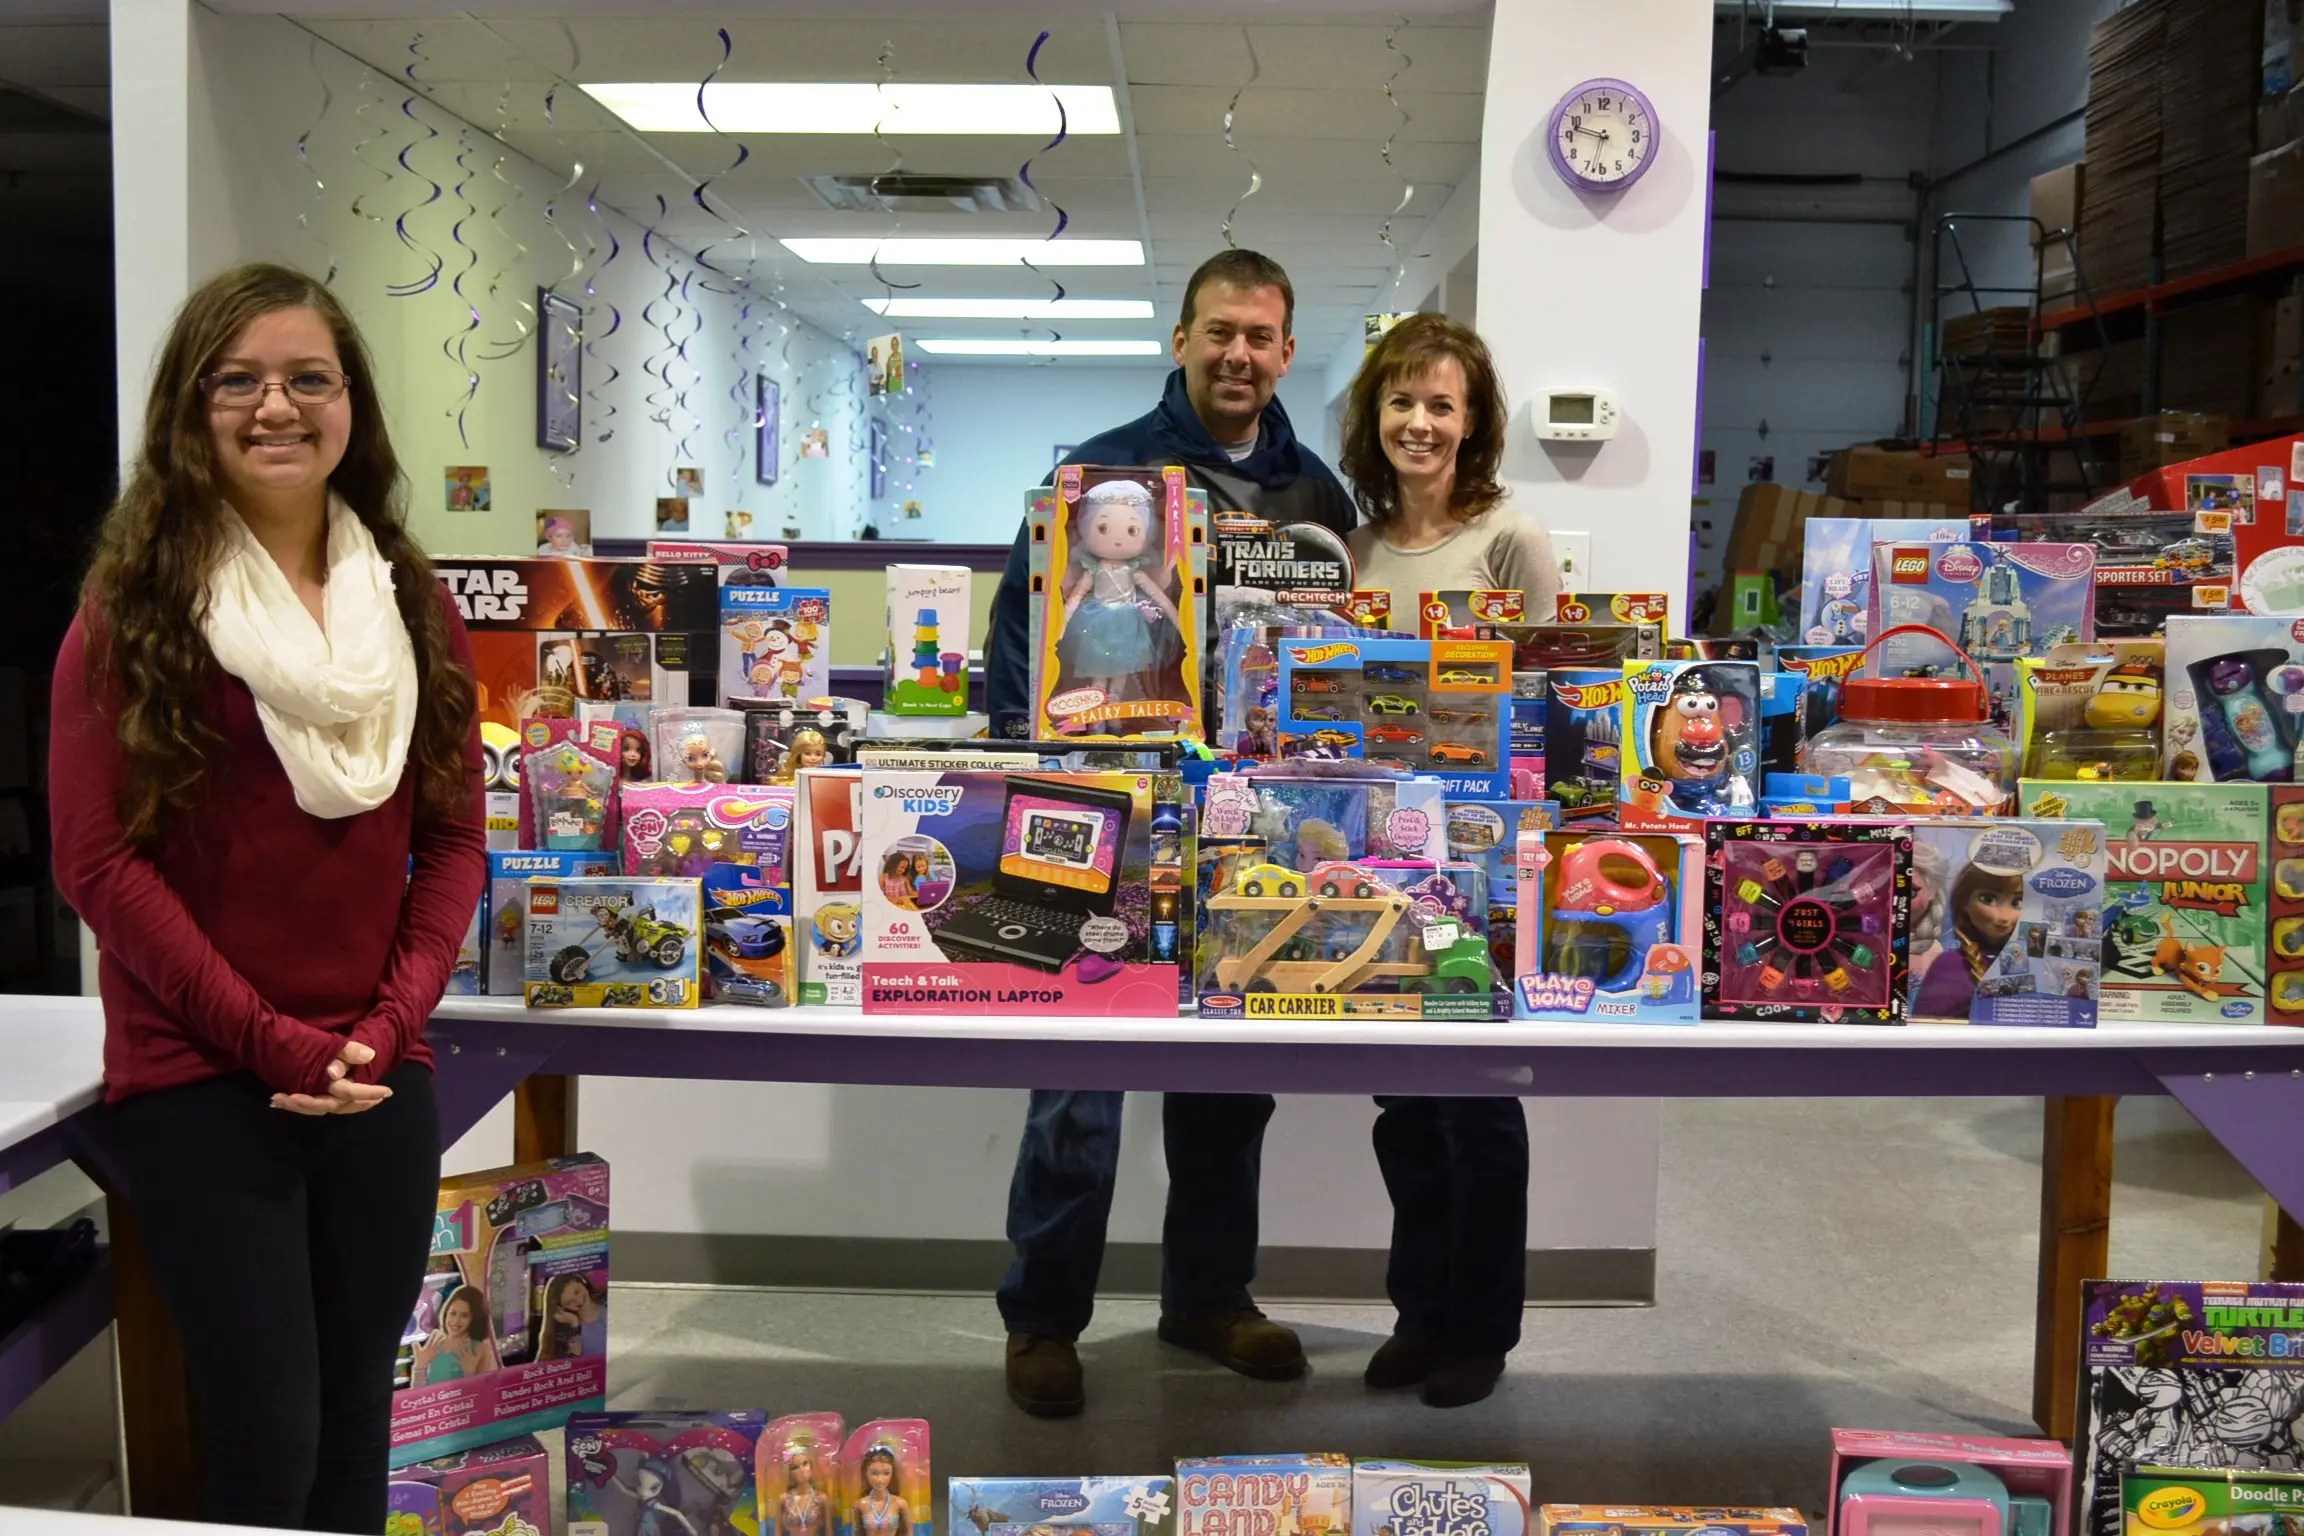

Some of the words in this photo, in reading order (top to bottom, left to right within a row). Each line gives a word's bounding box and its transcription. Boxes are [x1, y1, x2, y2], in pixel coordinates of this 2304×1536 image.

[1583, 103, 1591, 114] 11
[1597, 97, 1610, 110] 12
[1618, 102, 1623, 112] 1
[1571, 115, 1581, 127] 10
[1629, 114, 1636, 125] 2
[1565, 130, 1573, 142] 9
[1632, 130, 1640, 143] 3
[1570, 148, 1577, 159] 8
[1627, 149, 1635, 159] 4
[1584, 160, 1590, 171] 7
[1598, 163, 1606, 175] 6
[1615, 160, 1622, 171] 5
[1221, 541, 1295, 569] TRANS
[1894, 559, 1927, 573] LEGO
[1942, 559, 1979, 574] Disney
[1235, 560, 1341, 589] FORMERS
[2148, 571, 2167, 583] SET
[431, 569, 528, 595] TAR
[729, 591, 780, 602] PUZZLE
[1277, 590, 1345, 604] MECHTECH
[1890, 596, 1920, 610] 6-12
[458, 595, 528, 621] ARS
[1564, 608, 1584, 619] 1-5
[1306, 648, 1325, 663] HOT
[1325, 644, 1356, 658] WHEELS
[1444, 651, 1498, 659] DECORATION!
[1808, 659, 1839, 680] HOT
[2044, 671, 2085, 681] PLANES
[1629, 673, 1671, 693] Potato
[1579, 686, 1609, 707] HOT
[2035, 686, 2055, 696] FIRE
[2062, 686, 2095, 694] RESCUE
[1636, 691, 1666, 705] Head
[1080, 706, 1121, 724] FAIRY
[1129, 703, 1170, 718] TALES
[878, 759, 927, 768] ULTIMATE
[928, 760, 969, 768] STICKER
[1738, 753, 1751, 766] 13
[1463, 780, 1491, 793] PACK
[882, 785, 960, 803] Discovery
[904, 799, 950, 813] KIDS
[631, 821, 665, 841] PONY
[1624, 822, 1638, 830] Mr.
[1641, 822, 1666, 830] Potato
[1668, 822, 1690, 830] Head
[1736, 825, 1753, 837] BFF
[502, 857, 560, 870] PUZZLE
[2039, 878, 2087, 889] FROZEN
[730, 889, 748, 905] HOT
[747, 888, 780, 903] WHEELS
[2163, 881, 2246, 904] JUNIOR
[532, 893, 556, 906] LEGO
[564, 895, 629, 907] CREATOR
[1488, 909, 1503, 920] Go
[1793, 908, 1819, 916] JUST
[530, 923, 553, 934] 7-12
[889, 923, 909, 935] 60
[1796, 919, 1824, 927] GIRLS
[829, 963, 845, 971] kids
[872, 976, 912, 986] Teach
[917, 976, 928, 986] &
[930, 975, 959, 986] Talk
[649, 978, 666, 1004] 3
[872, 990, 991, 1002] EXPLORATION
[997, 990, 1063, 1003] LAPTOP
[1250, 997, 1271, 1014] CAR
[1273, 997, 1336, 1015] CARRIER
[1527, 992, 1588, 1010] HOME
[1596, 1003, 1636, 1014] MIXER
[2202, 1297, 2245, 1305] TEENAGE
[2202, 1306, 2304, 1328] TURTLE
[2182, 1331, 2265, 1354] Velvet
[523, 1367, 544, 1380] Rock
[533, 1380, 554, 1392] Rock
[557, 1374, 574, 1386] And
[401, 1393, 436, 1410] Crystal
[437, 1388, 462, 1400] Gems
[531, 1398, 543, 1408] De
[577, 1384, 599, 1396] Rock
[428, 1409, 440, 1419] En
[442, 1399, 474, 1415] Cristal
[392, 1429, 422, 1442] Gemas
[424, 1424, 437, 1435] De
[439, 1415, 470, 1431] Cristal
[572, 1439, 602, 1457] PONY
[1183, 1473, 1309, 1507] CANDY
[2231, 1486, 2288, 1502] Doodle
[1040, 1498, 1082, 1508] FROZEN
[1132, 1497, 1144, 1509] 5
[1392, 1481, 1487, 1522] Chutes
[2148, 1496, 2196, 1511] Crayola
[1183, 1508, 1276, 1536] LAND
[1406, 1517, 1424, 1528] and
